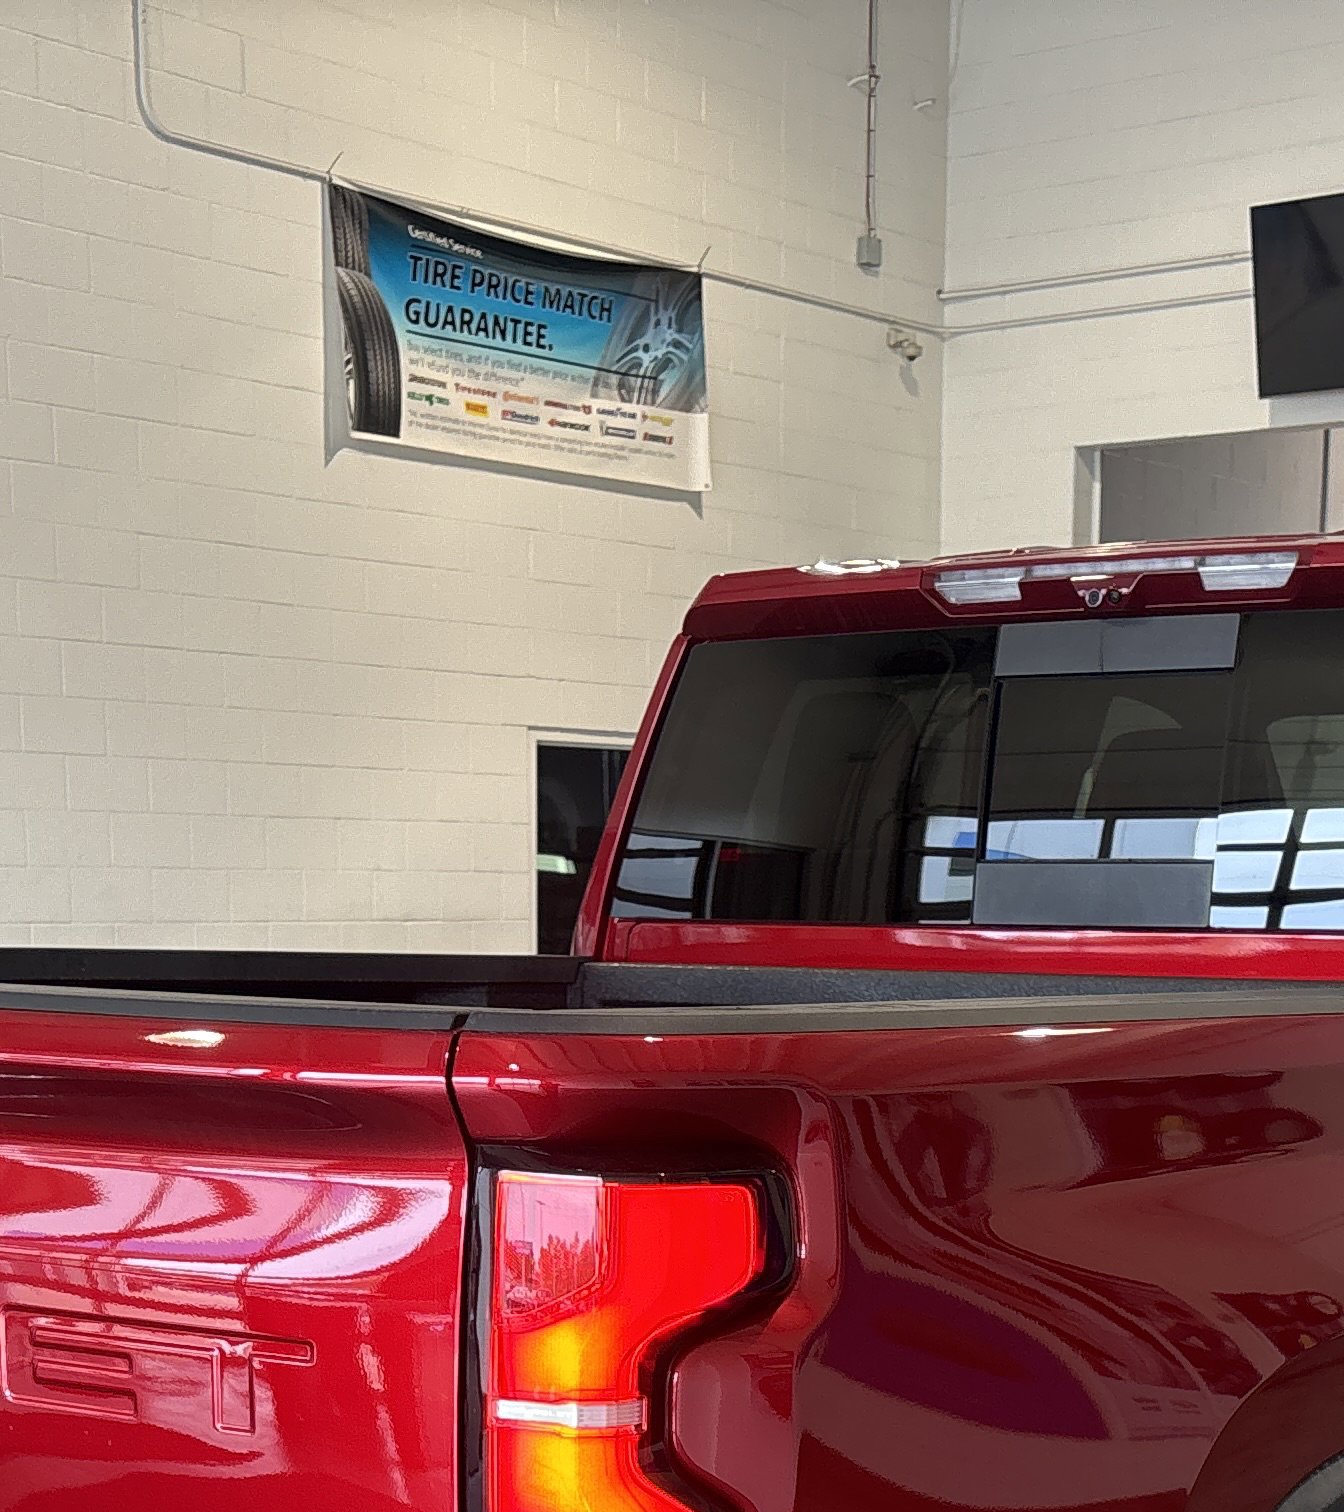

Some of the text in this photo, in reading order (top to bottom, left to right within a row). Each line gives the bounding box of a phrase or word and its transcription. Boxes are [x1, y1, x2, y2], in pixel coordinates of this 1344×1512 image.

[408, 254, 615, 323] TIRE PRICE MATCH
[404, 297, 554, 352] GUARANTEE.
